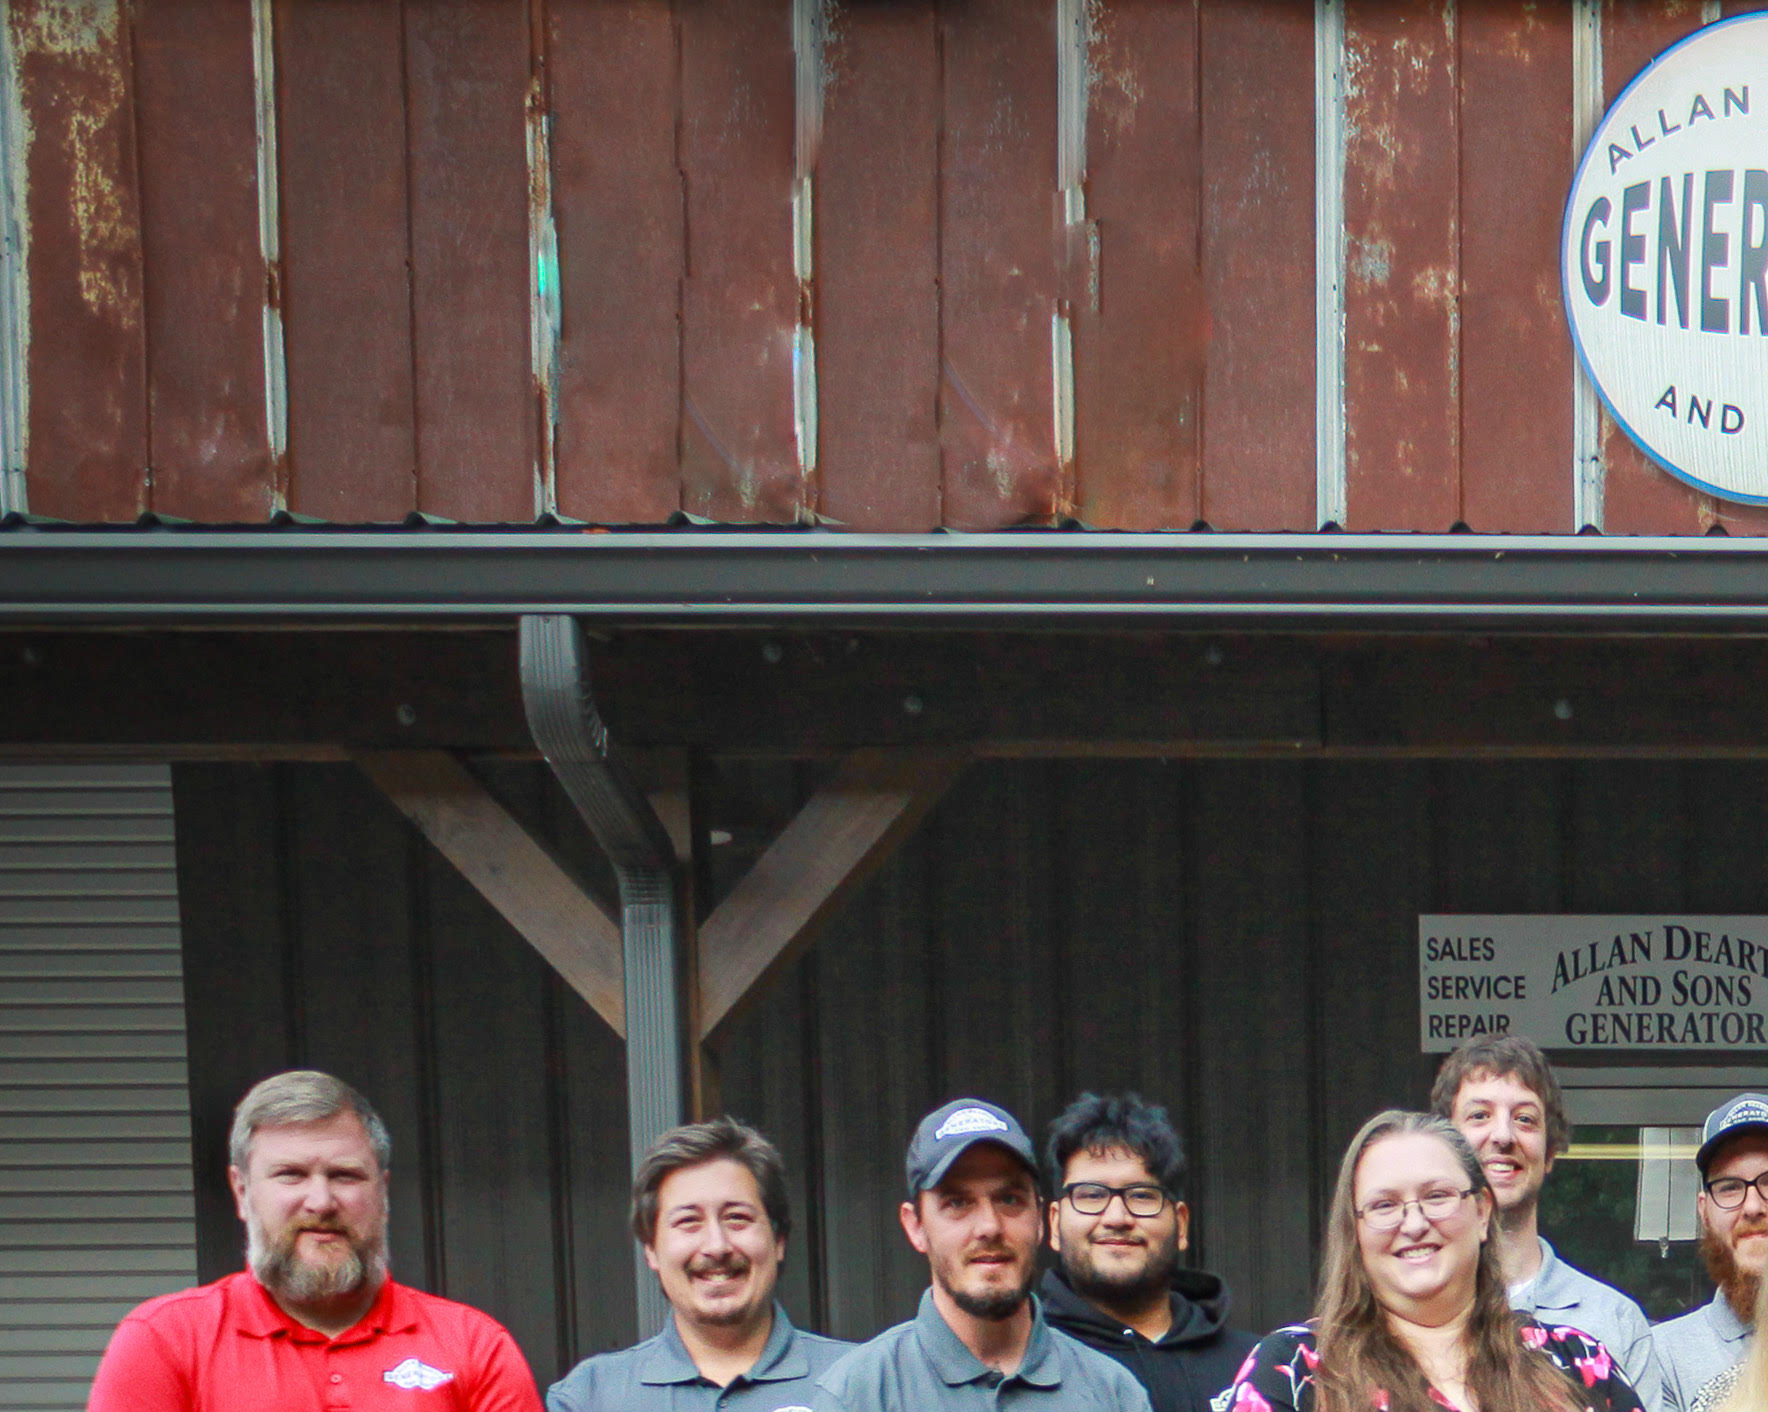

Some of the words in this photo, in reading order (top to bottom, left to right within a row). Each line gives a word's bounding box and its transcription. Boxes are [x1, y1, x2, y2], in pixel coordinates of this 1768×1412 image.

[1606, 85, 1750, 175] ALLAN
[1654, 385, 1745, 435] AND
[1426, 937, 1496, 962] SALES
[1550, 931, 1654, 994] ALLAN
[1427, 975, 1527, 1000] SERVICE
[1594, 975, 1662, 1007] AND
[1671, 969, 1753, 1007] SONS
[1428, 1014, 1511, 1039] REPAIR
